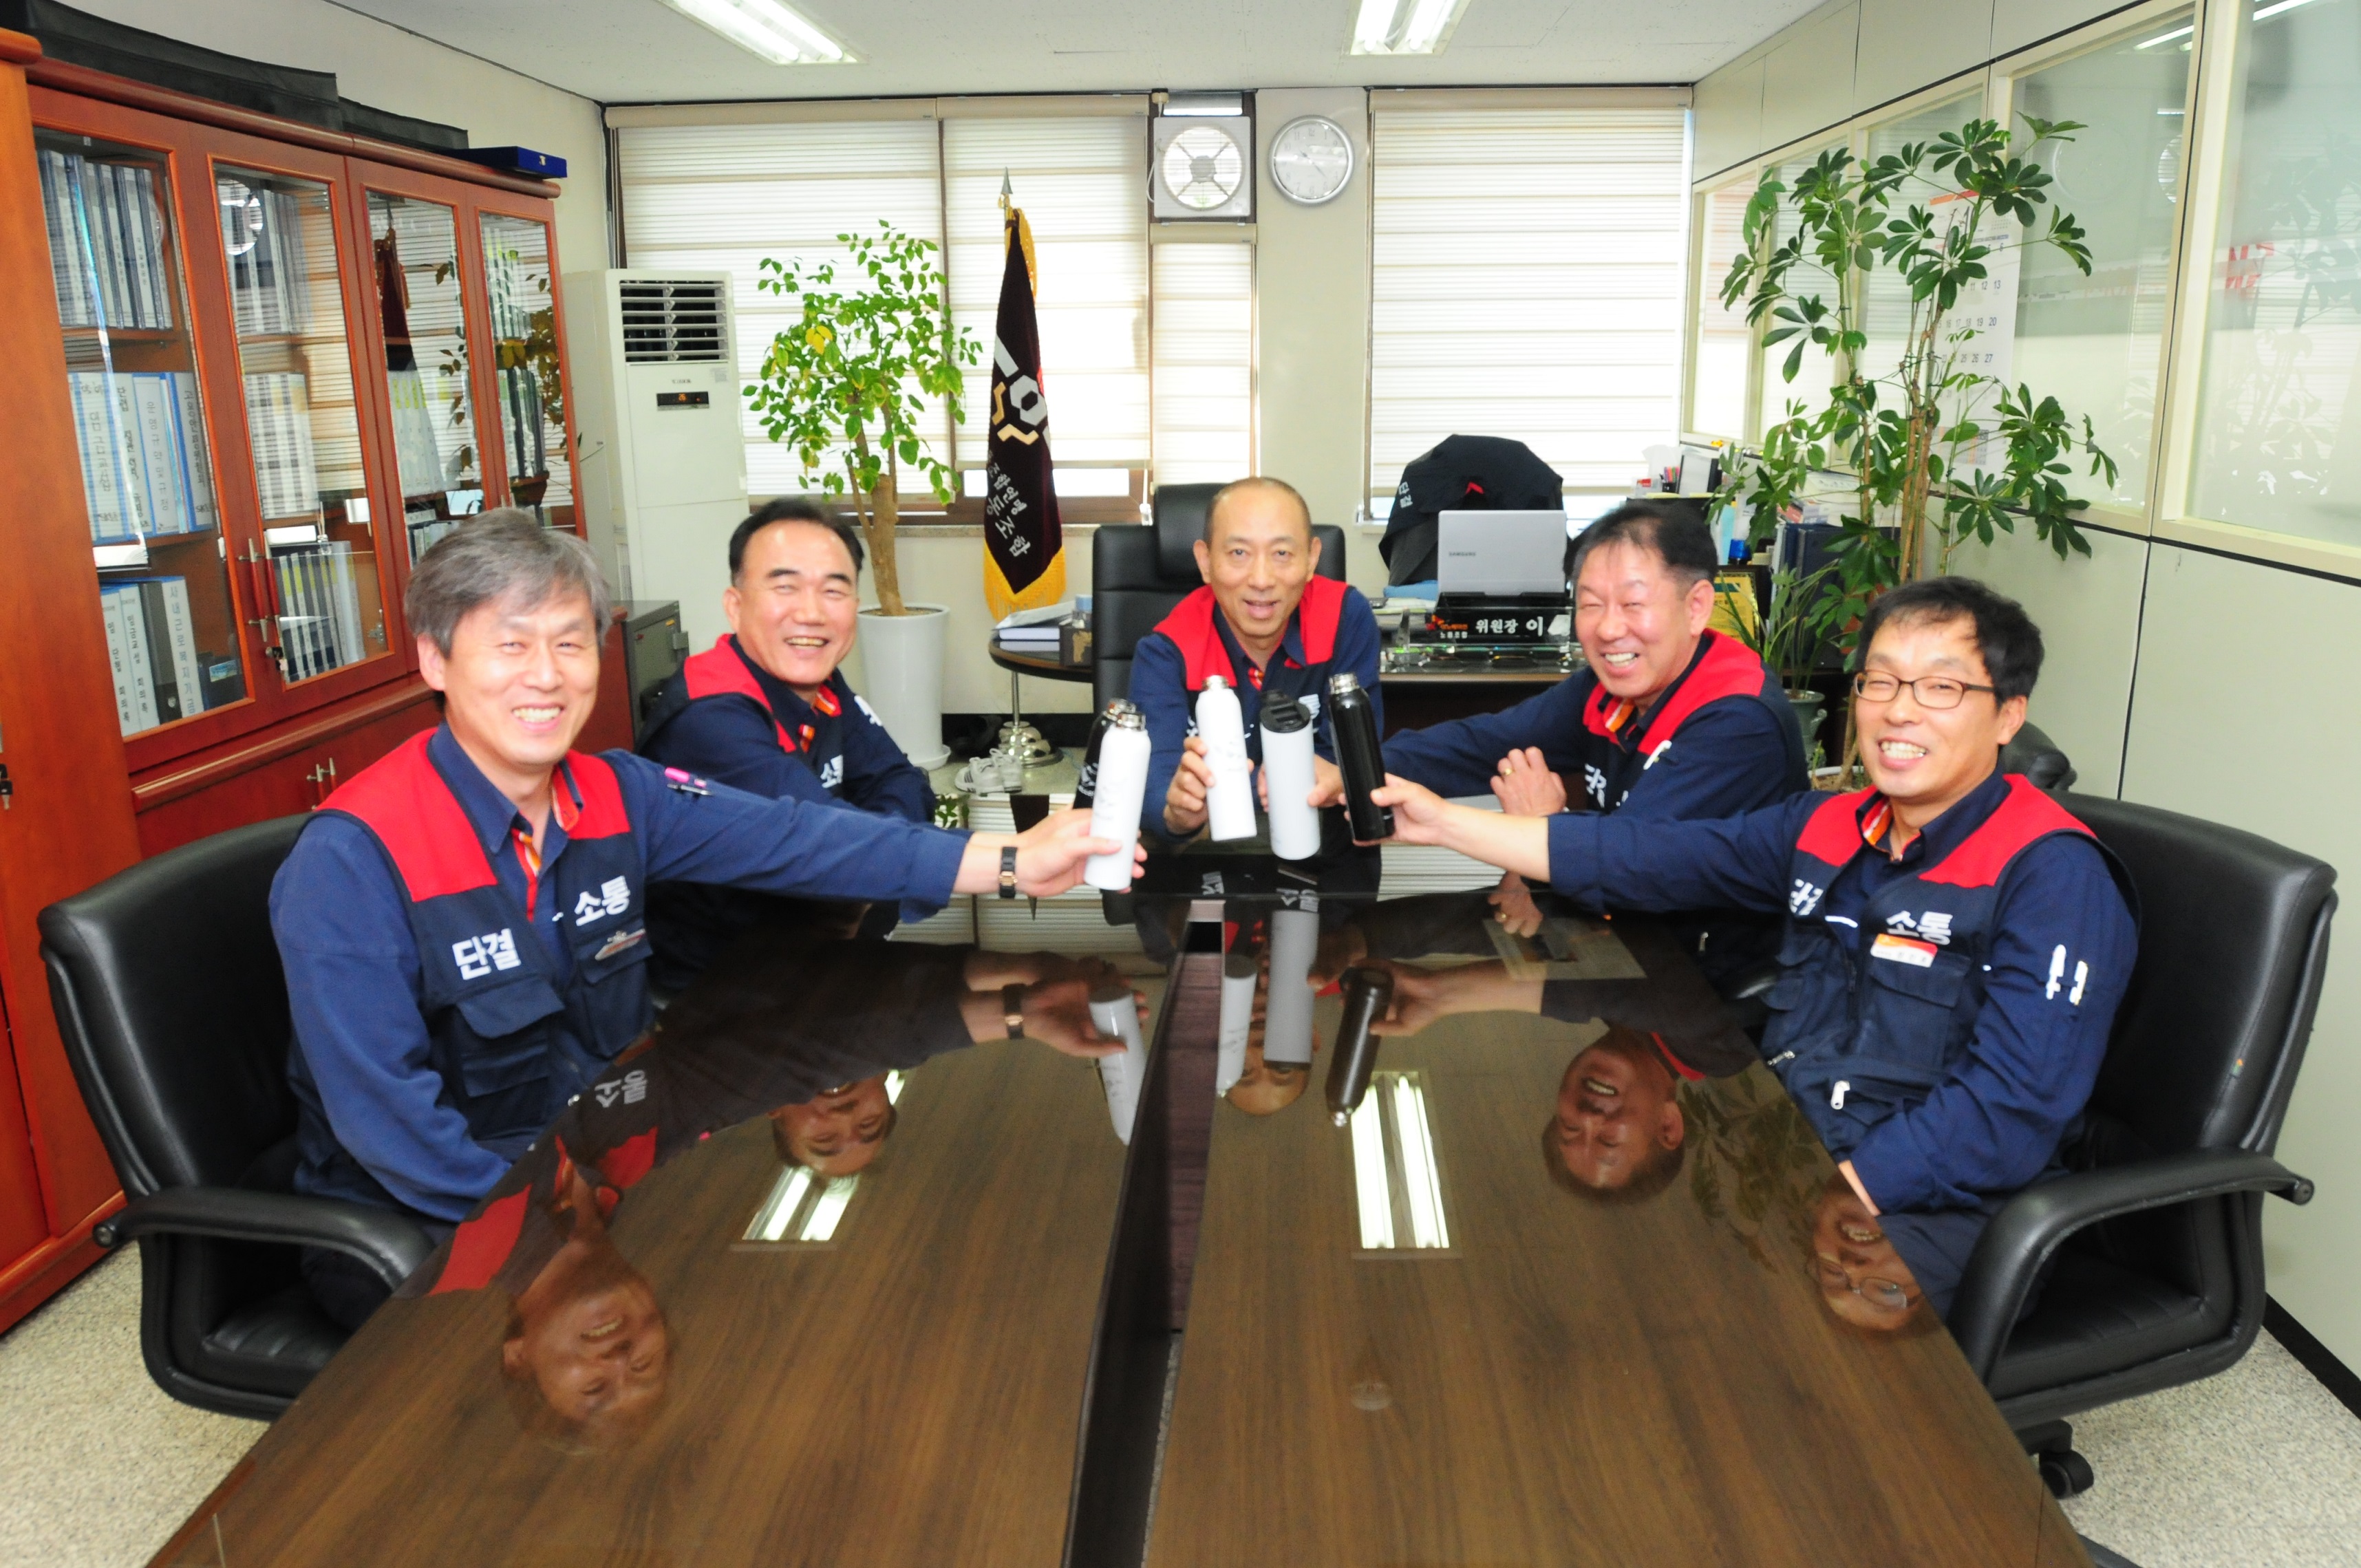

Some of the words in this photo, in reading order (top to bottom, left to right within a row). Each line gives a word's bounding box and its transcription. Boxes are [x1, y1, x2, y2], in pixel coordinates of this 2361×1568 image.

[1981, 281, 1988, 290] 12
[1994, 280, 2001, 289] 13
[1976, 317, 1983, 326] 19
[1989, 317, 1997, 326] 20
[1961, 354, 1967, 363] 25
[1972, 354, 1979, 363] 26
[1985, 354, 1993, 363] 27
[1475, 619, 1518, 634] 위원장
[1526, 616, 1543, 636] 이
[451, 927, 521, 980] 단결
[574, 875, 631, 926] 소통
[1886, 910, 1953, 945] 소통
